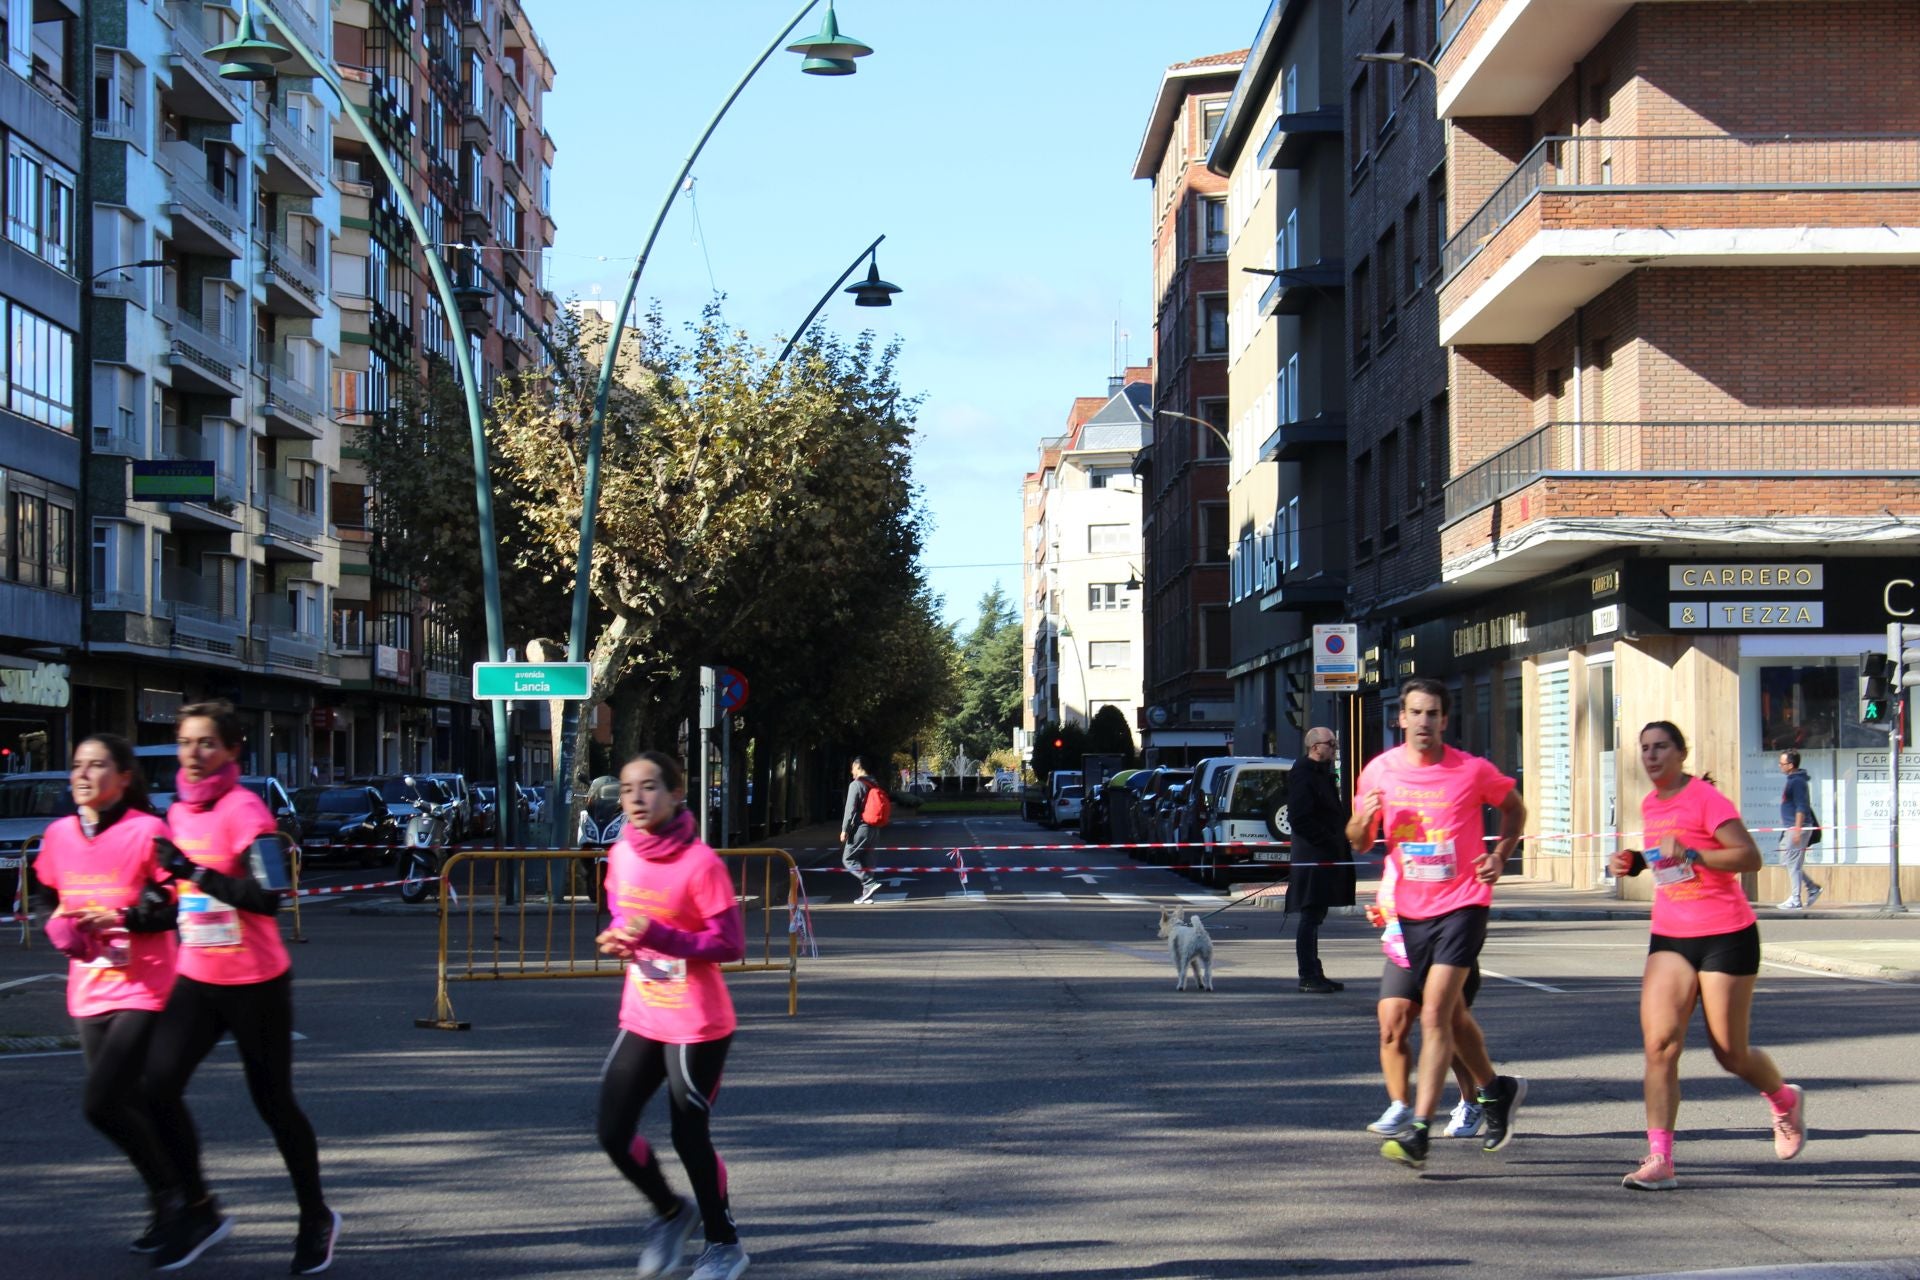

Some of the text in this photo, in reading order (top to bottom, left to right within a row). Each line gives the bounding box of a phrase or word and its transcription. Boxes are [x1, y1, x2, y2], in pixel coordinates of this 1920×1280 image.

[1682, 569, 1812, 586] CARRERO
[1681, 607, 1812, 624] & TEZZA
[514, 681, 550, 692] Lancia
[1863, 756, 1920, 764] CARERO
